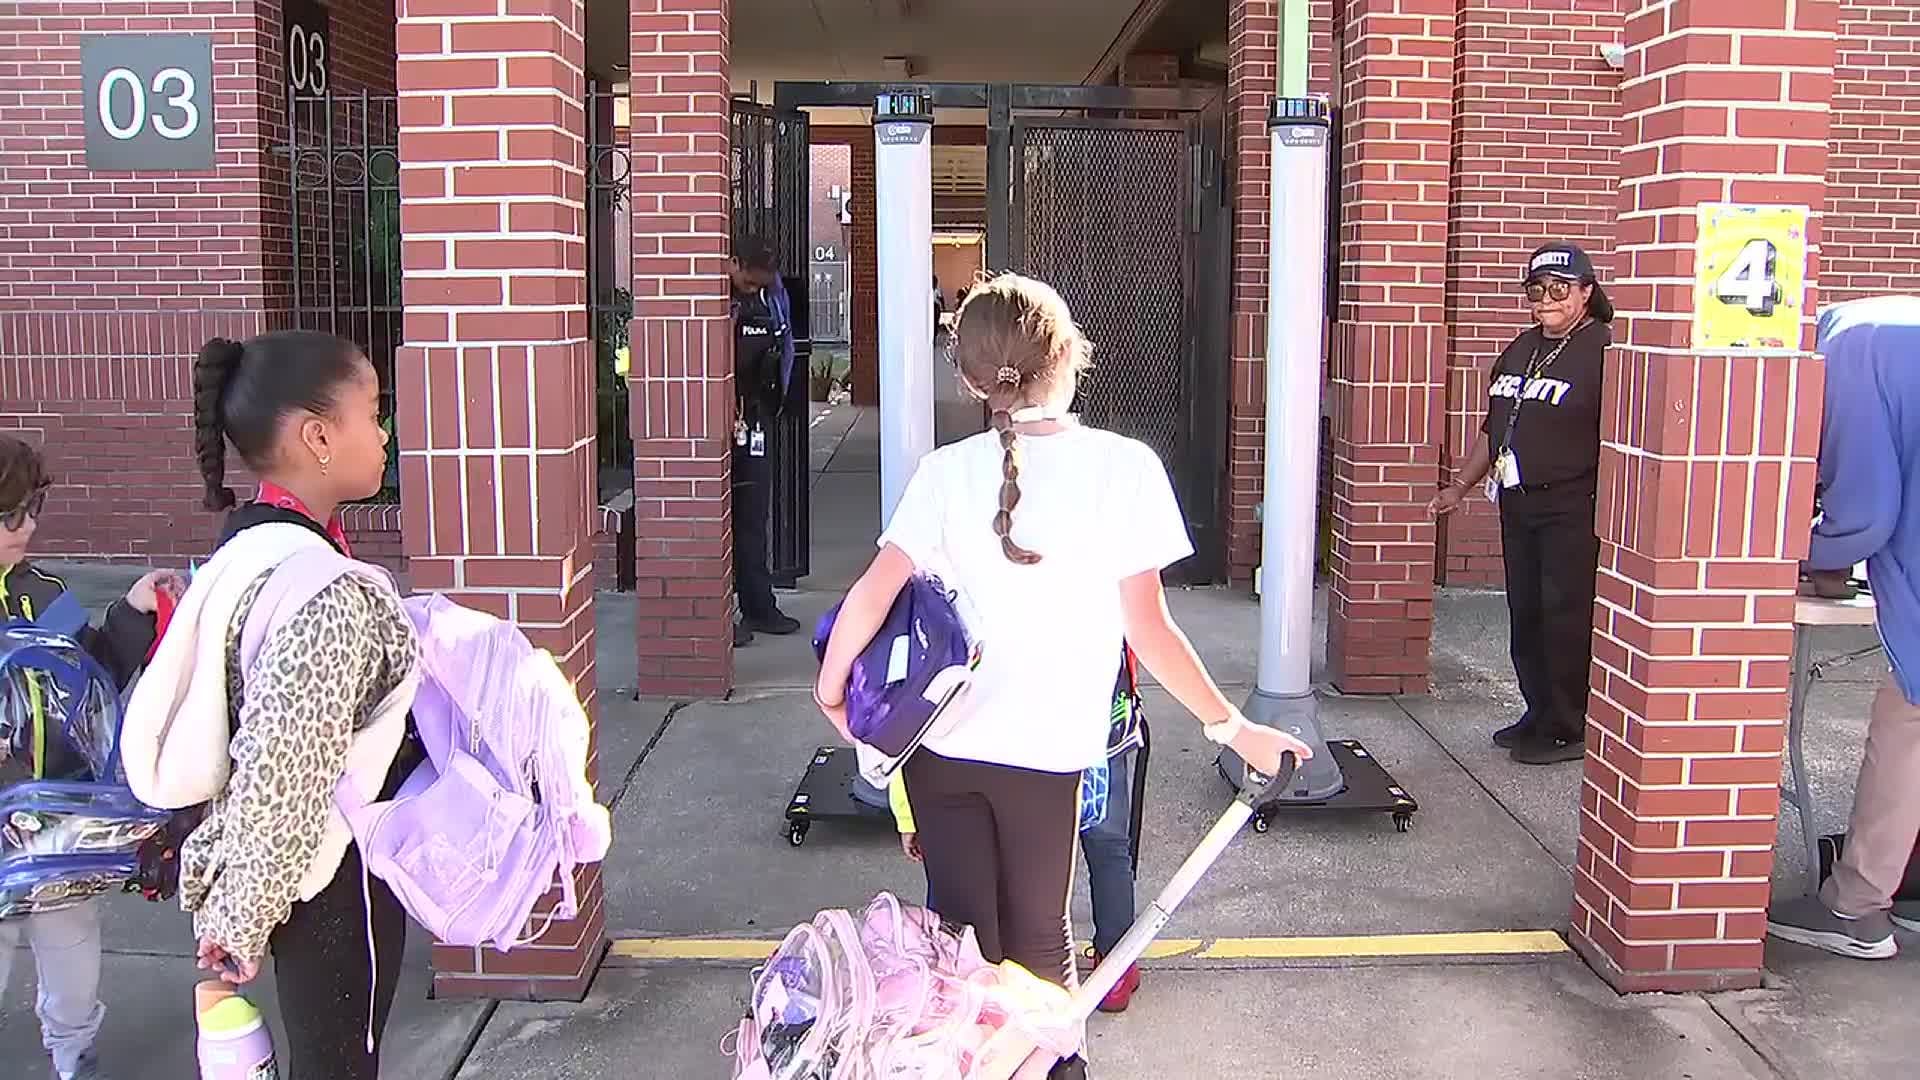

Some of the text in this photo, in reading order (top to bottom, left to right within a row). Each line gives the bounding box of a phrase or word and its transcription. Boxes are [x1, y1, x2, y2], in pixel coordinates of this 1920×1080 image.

[289, 24, 327, 96] 03
[98, 67, 200, 140] 03
[815, 246, 835, 260] 04
[1716, 238, 1783, 317] 4
